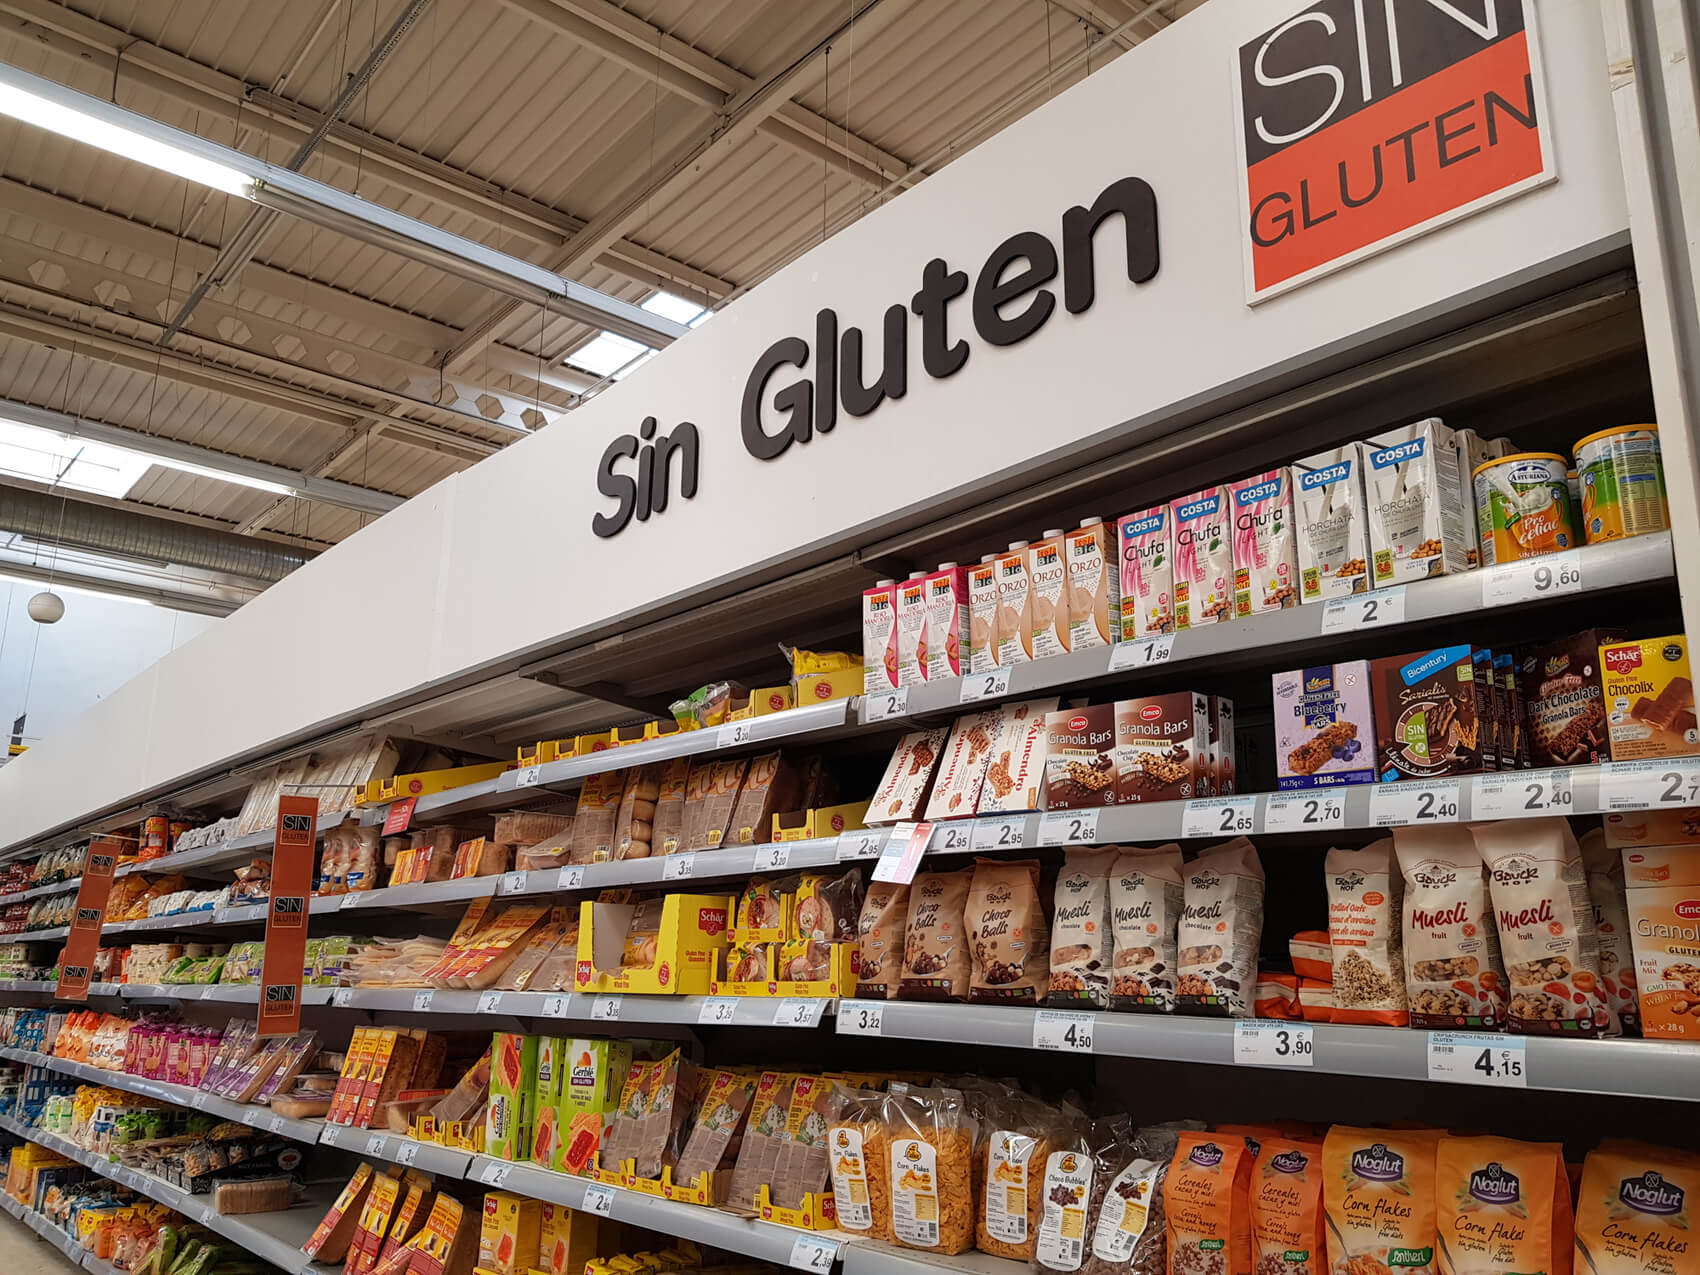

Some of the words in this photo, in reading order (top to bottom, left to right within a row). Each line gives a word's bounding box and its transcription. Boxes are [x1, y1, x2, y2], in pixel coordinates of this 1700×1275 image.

[1254, 0, 1499, 144] SIN
[1250, 74, 1537, 247] GLUTEN
[592, 416, 700, 539] Sin
[741, 177, 1160, 461] Gluten
[1376, 443, 1421, 464] COSTA
[1304, 466, 1346, 485] COSTA
[1240, 483, 1278, 501] COSTA
[1374, 489, 1430, 514] HORCHATA
[1180, 500, 1216, 516] COSTA
[1127, 518, 1160, 534] COSTA
[1237, 506, 1282, 530] Chufa
[1302, 514, 1355, 533] HORCHATA
[1524, 515, 1545, 529] Pro
[1178, 523, 1221, 545] Chufa
[1124, 540, 1164, 561] Chufa
[1069, 558, 1101, 574] ORZO
[1032, 568, 1062, 584] ORZO
[1534, 566, 1580, 591] 9,60
[998, 579, 1027, 594] ORZO
[970, 591, 996, 604] ORZO
[1362, 600, 1378, 622] 2
[1143, 643, 1169, 662] 1,99
[1607, 650, 1640, 662] Schär
[1407, 653, 1447, 678] Bicentury
[983, 676, 1006, 696] 2,60
[1608, 681, 1655, 697] Chocolix
[1294, 702, 1347, 717] Blueberry
[1528, 699, 1549, 715] Dark
[1551, 685, 1600, 707] Chocolate
[1542, 710, 1568, 724] Granola
[1569, 707, 1586, 717] Bars
[1048, 731, 1087, 745] Granola
[1090, 729, 1112, 744] Bars
[1120, 721, 1160, 735] Granola
[1164, 720, 1188, 735] Bars
[1407, 726, 1425, 735] SIN
[943, 730, 967, 786] Almendro
[1016, 726, 1039, 791] Almendro
[885, 745, 913, 797] Almendro
[1319, 776, 1335, 784] BARS
[1524, 783, 1572, 809] 2,40
[1303, 800, 1340, 823] 2,70
[1416, 792, 1457, 820] 2,40
[283, 815, 311, 831] SIN
[1219, 808, 1252, 832] 2,65
[281, 832, 309, 841] GLUTEN
[945, 830, 967, 848] 2,95
[998, 825, 1023, 845] 2,95
[1068, 820, 1095, 840] 2,65
[858, 838, 878, 856] 2,95
[91, 855, 113, 866] SIN
[78, 909, 100, 920] SIN
[275, 898, 302, 913] SIN
[917, 902, 941, 916] Choco
[1056, 901, 1091, 922] Muesli
[1114, 901, 1152, 923] Muesli
[1180, 901, 1222, 920] Muesli
[274, 914, 301, 923] GLUTEN
[700, 910, 725, 923] Schär
[915, 914, 937, 930] Balls
[982, 909, 1012, 923] Choco
[1412, 901, 1468, 930] Muesli
[1500, 899, 1554, 932] Muesli
[981, 921, 1009, 939] Balls
[1185, 923, 1211, 931] chocolate
[1637, 919, 1700, 941] Granol
[64, 966, 88, 977] SIN
[1640, 959, 1657, 968] Fruit
[1643, 966, 1657, 975] Mix
[266, 986, 295, 1001] SIN
[265, 1003, 293, 1012] GLUTEN
[858, 1010, 879, 1029] 3,22
[1064, 1023, 1091, 1048] 4,50
[1275, 1031, 1312, 1056] 3,90
[573, 1066, 594, 1077] Gerblé
[1474, 1048, 1522, 1077] 4,15
[913, 1164, 930, 1173] Flakes
[1353, 1154, 1402, 1173] Noglut
[1065, 1176, 1087, 1186] Bubbles
[1179, 1175, 1212, 1191] Cereales
[1472, 1176, 1517, 1196] Noglut
[1262, 1183, 1300, 1200] Cereales
[1622, 1183, 1682, 1207] Noglut
[1343, 1194, 1370, 1212] Corn
[1372, 1198, 1412, 1218] flakes
[1455, 1215, 1486, 1235] Corn
[1488, 1222, 1525, 1241] flakes
[1602, 1223, 1638, 1242] Corn
[1640, 1232, 1688, 1253] flakes
